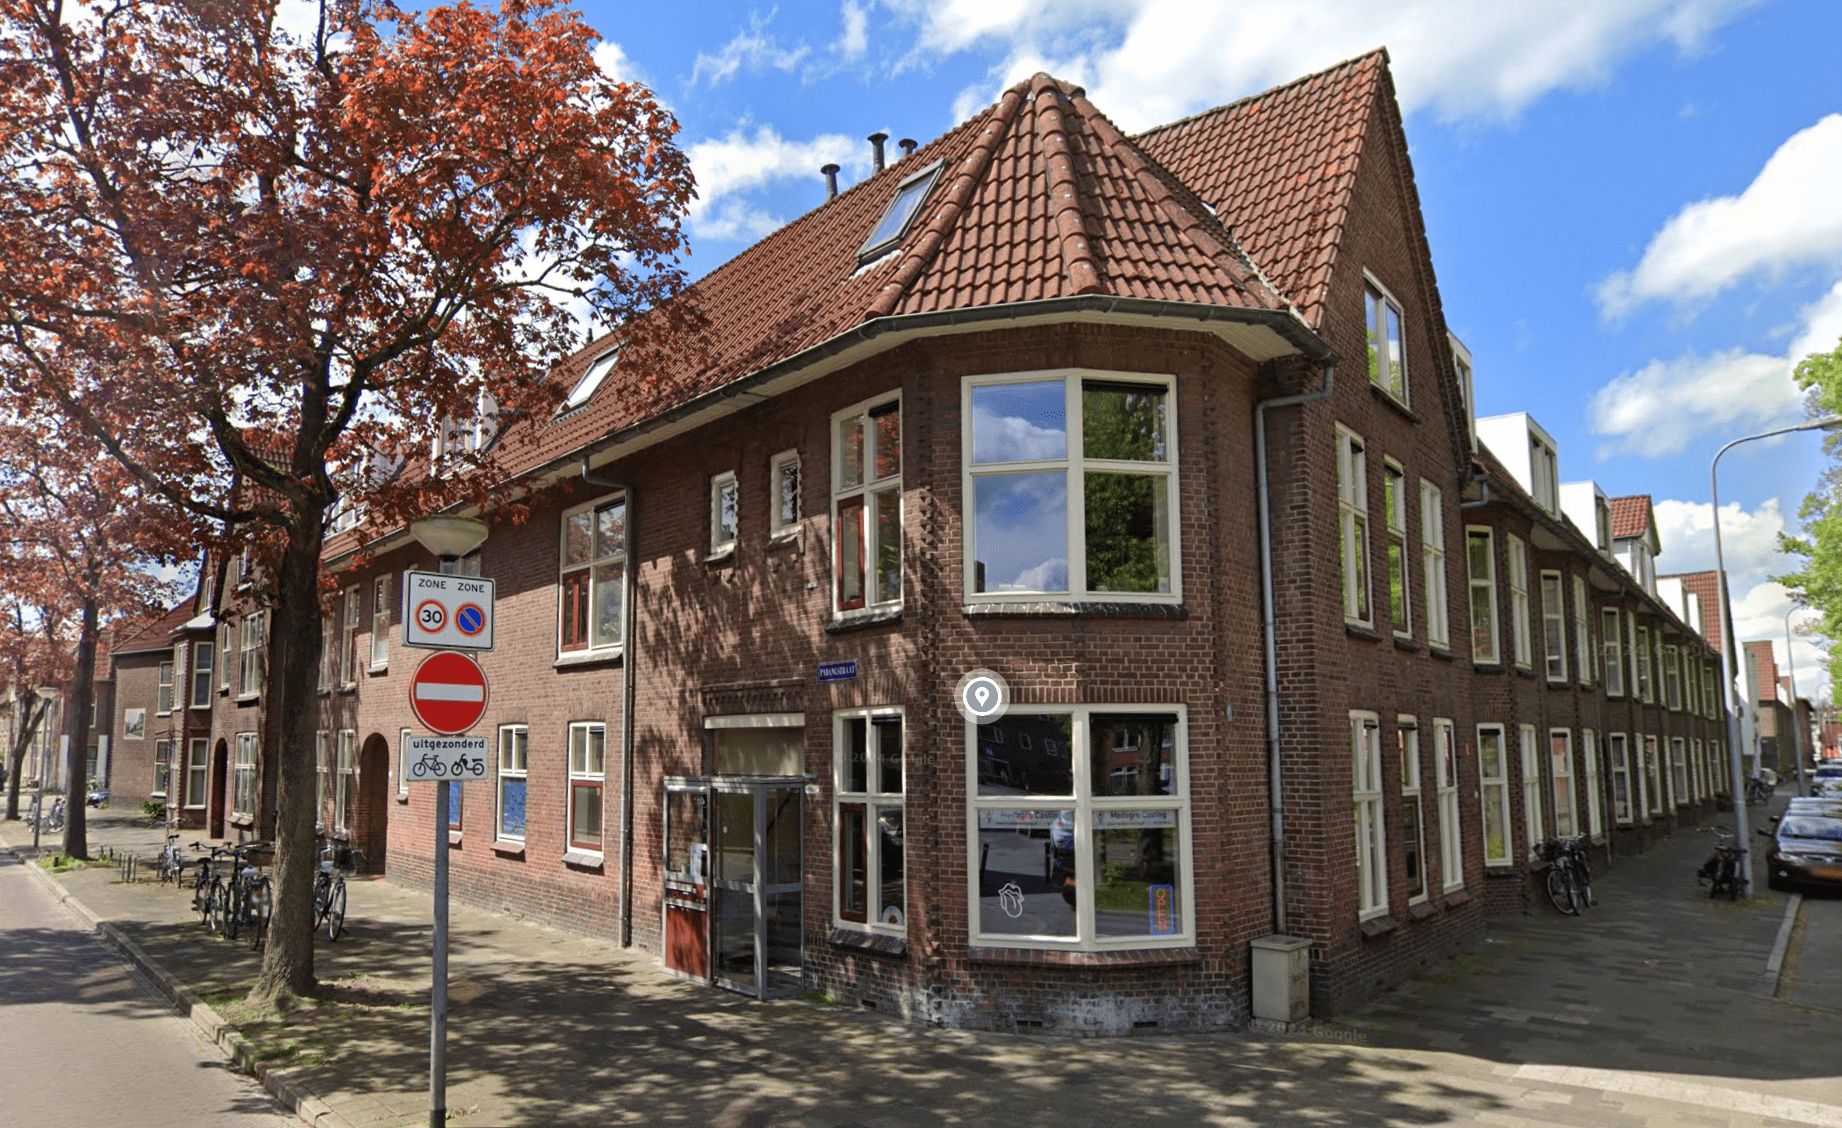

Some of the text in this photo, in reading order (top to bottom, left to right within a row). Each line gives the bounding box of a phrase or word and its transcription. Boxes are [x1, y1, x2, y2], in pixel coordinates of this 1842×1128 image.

[418, 578, 485, 593] ZONE ZONE
[422, 609, 442, 624] 30
[413, 739, 485, 751] uitgezonderd
